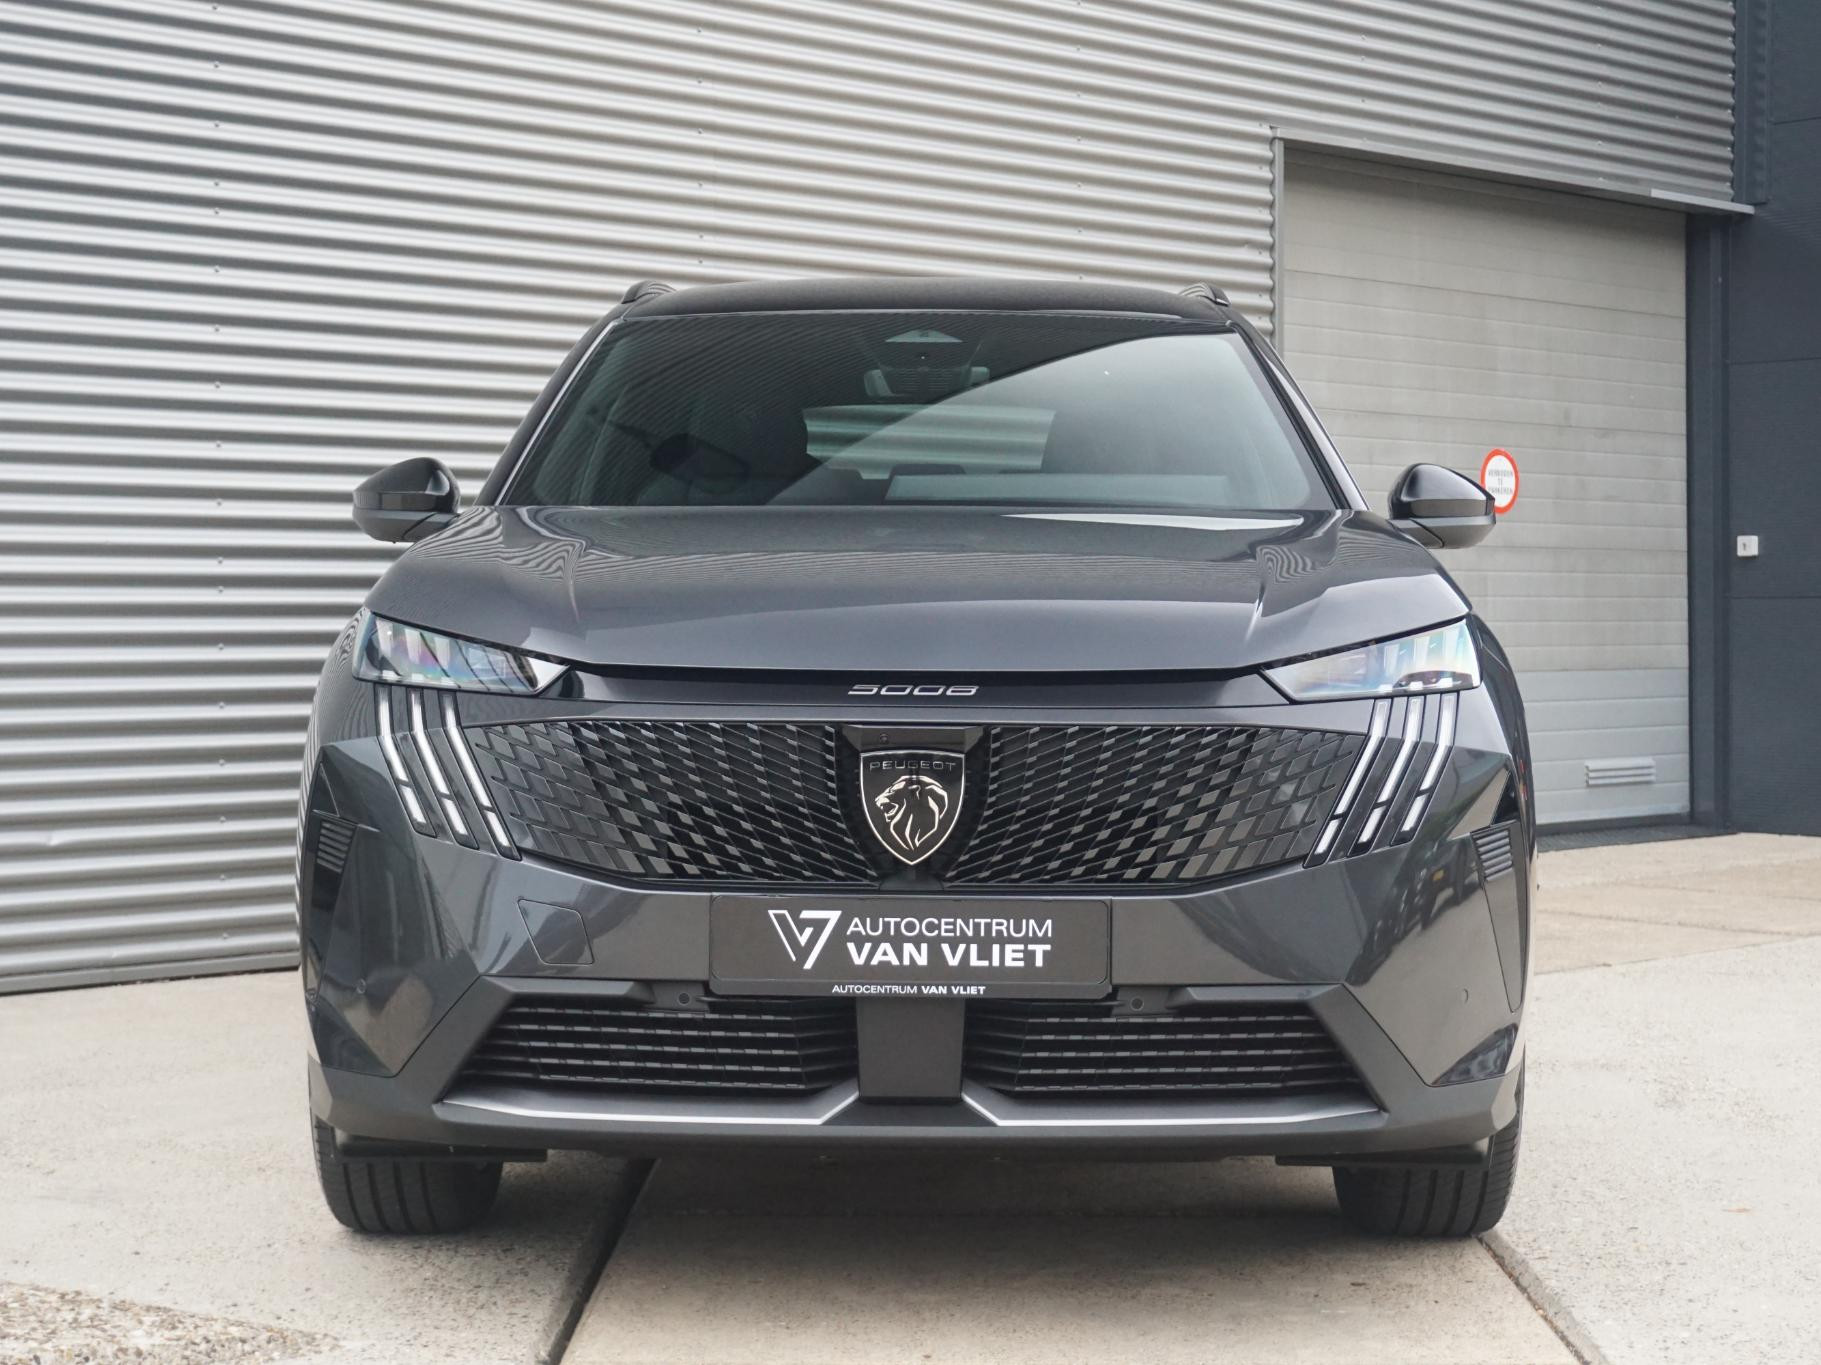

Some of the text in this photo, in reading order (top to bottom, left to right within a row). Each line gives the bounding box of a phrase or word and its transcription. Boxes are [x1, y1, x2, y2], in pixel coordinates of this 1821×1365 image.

[848, 684, 979, 696] 5008
[869, 760, 956, 771] PEUGEOT
[846, 917, 1053, 937] AUTOCENTRUM
[846, 942, 1052, 967] VAN VLIET
[832, 984, 986, 996] AUTOCENTRUM VAN VLIET
